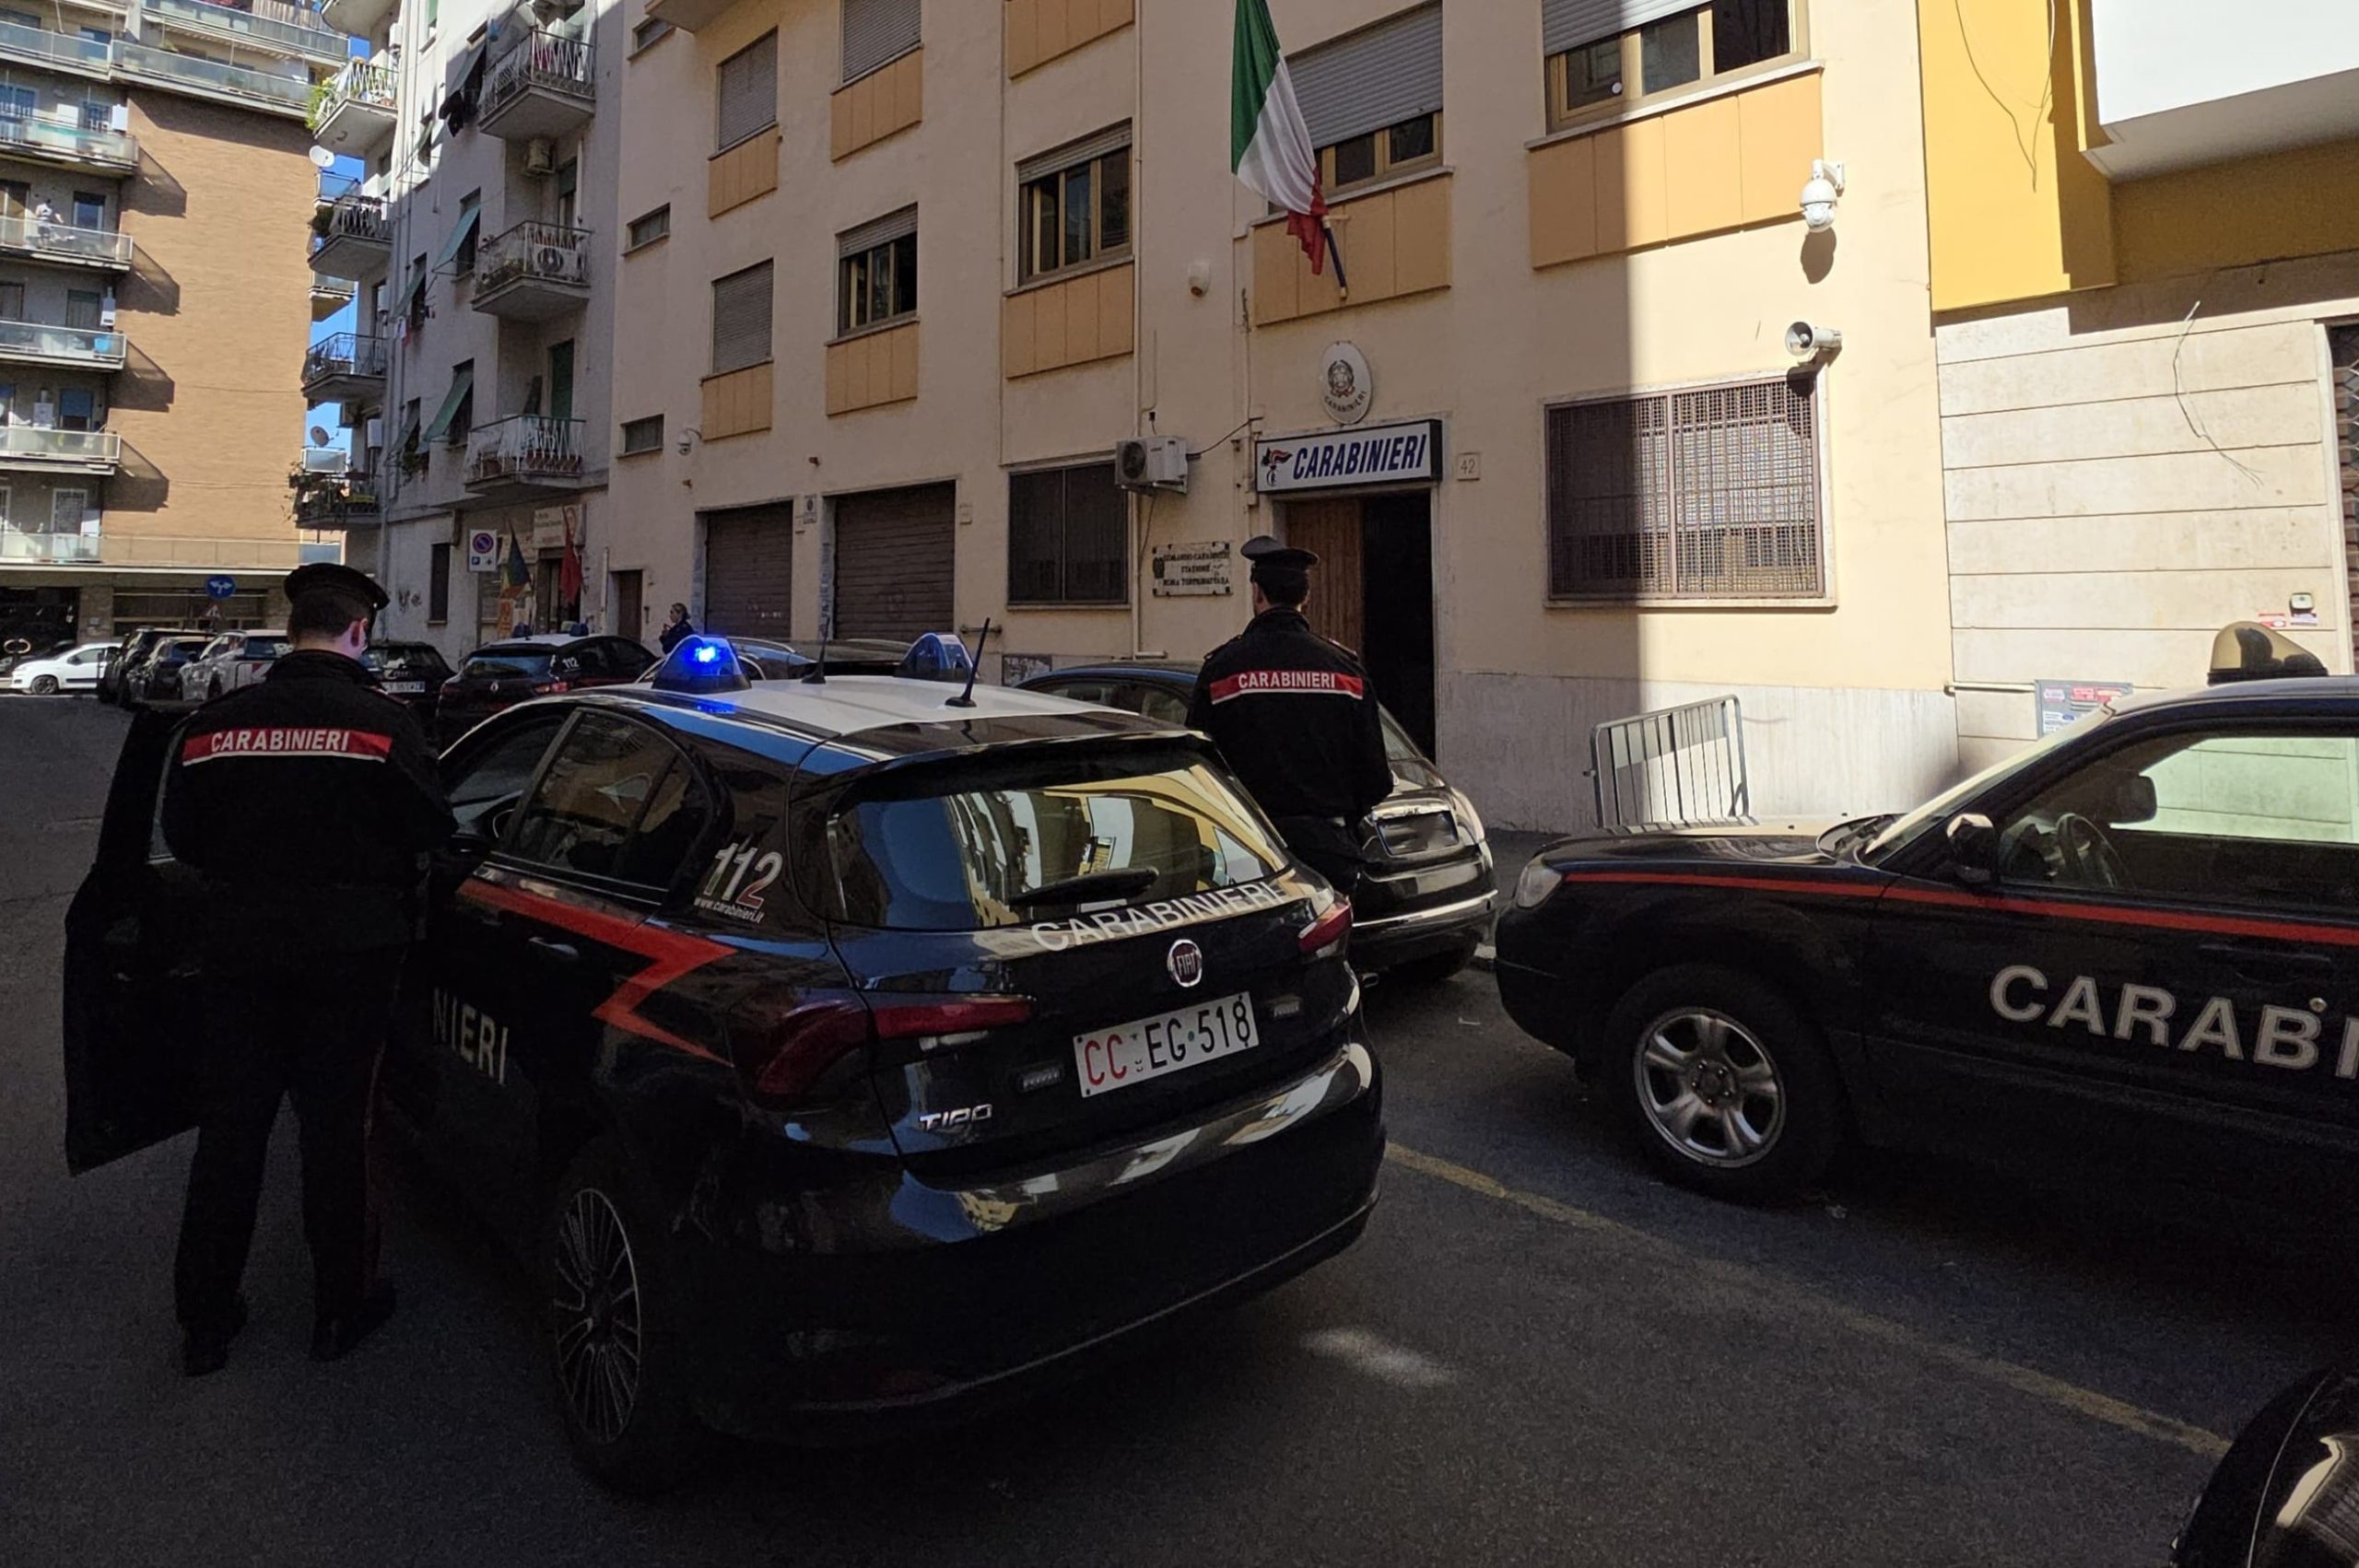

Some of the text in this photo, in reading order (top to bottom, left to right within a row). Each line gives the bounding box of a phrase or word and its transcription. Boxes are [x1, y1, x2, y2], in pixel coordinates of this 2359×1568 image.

[1324, 390, 1367, 413] CARABINIERI
[1293, 434, 1427, 480] CARABINIERI
[1460, 459, 1475, 474] 42
[562, 656, 580, 670] 112
[1238, 672, 1336, 689] CARABINIERI
[211, 729, 349, 753] CARABINIERI
[703, 842, 783, 910] 112
[693, 896, 765, 923] www.carabinieri.it
[1030, 880, 1285, 952] CARABINIERI
[1176, 951, 1198, 977] FIAT
[1989, 965, 2359, 1081] CARABI
[1085, 1000, 1251, 1086] CC EG 518
[920, 1104, 993, 1132] TIPO
